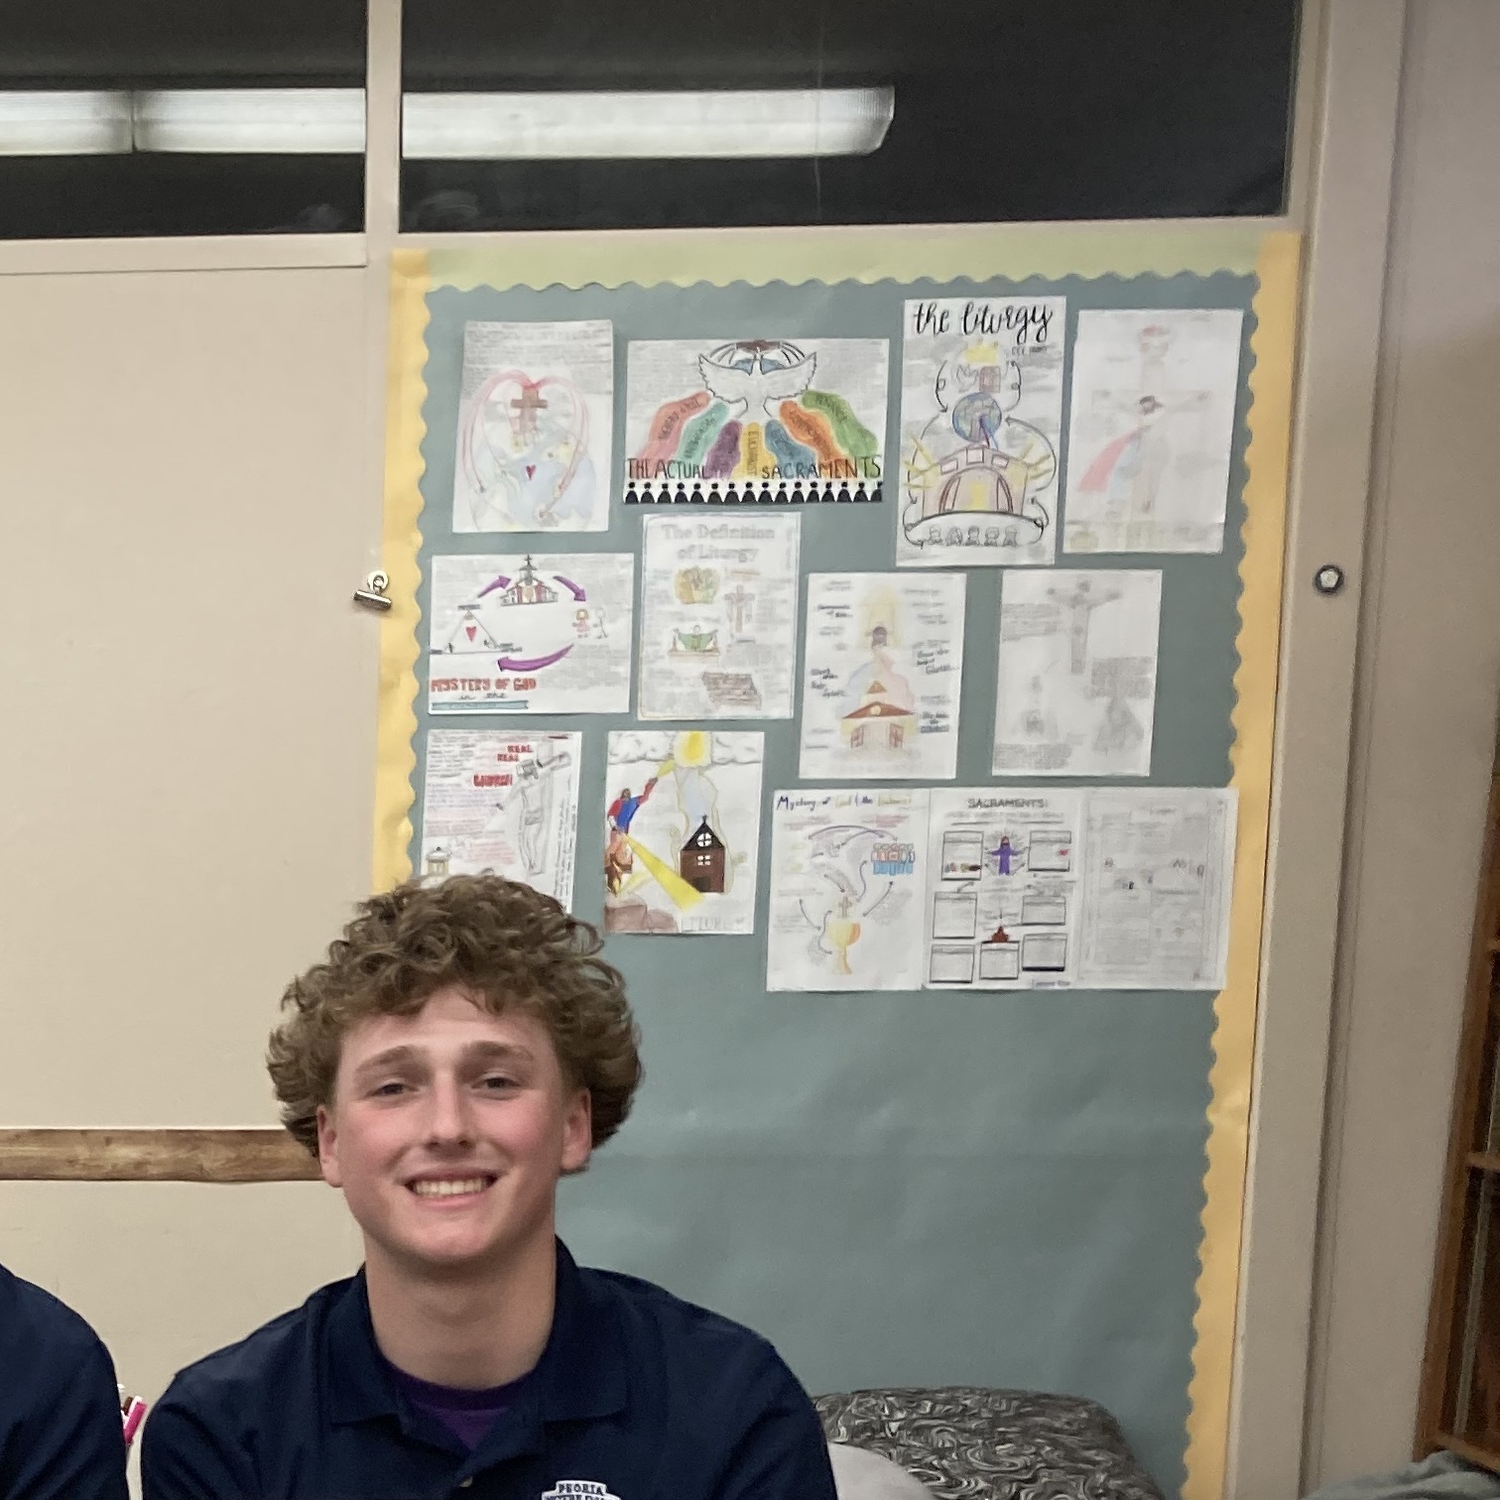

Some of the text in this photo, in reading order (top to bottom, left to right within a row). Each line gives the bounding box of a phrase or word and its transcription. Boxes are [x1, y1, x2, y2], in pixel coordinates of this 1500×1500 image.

[914, 301, 1053, 346] the liturgy
[654, 459, 711, 480] ACTUAL
[761, 454, 882, 480] SACRAMENTS
[558, 1483, 604, 1496] PEORIA
